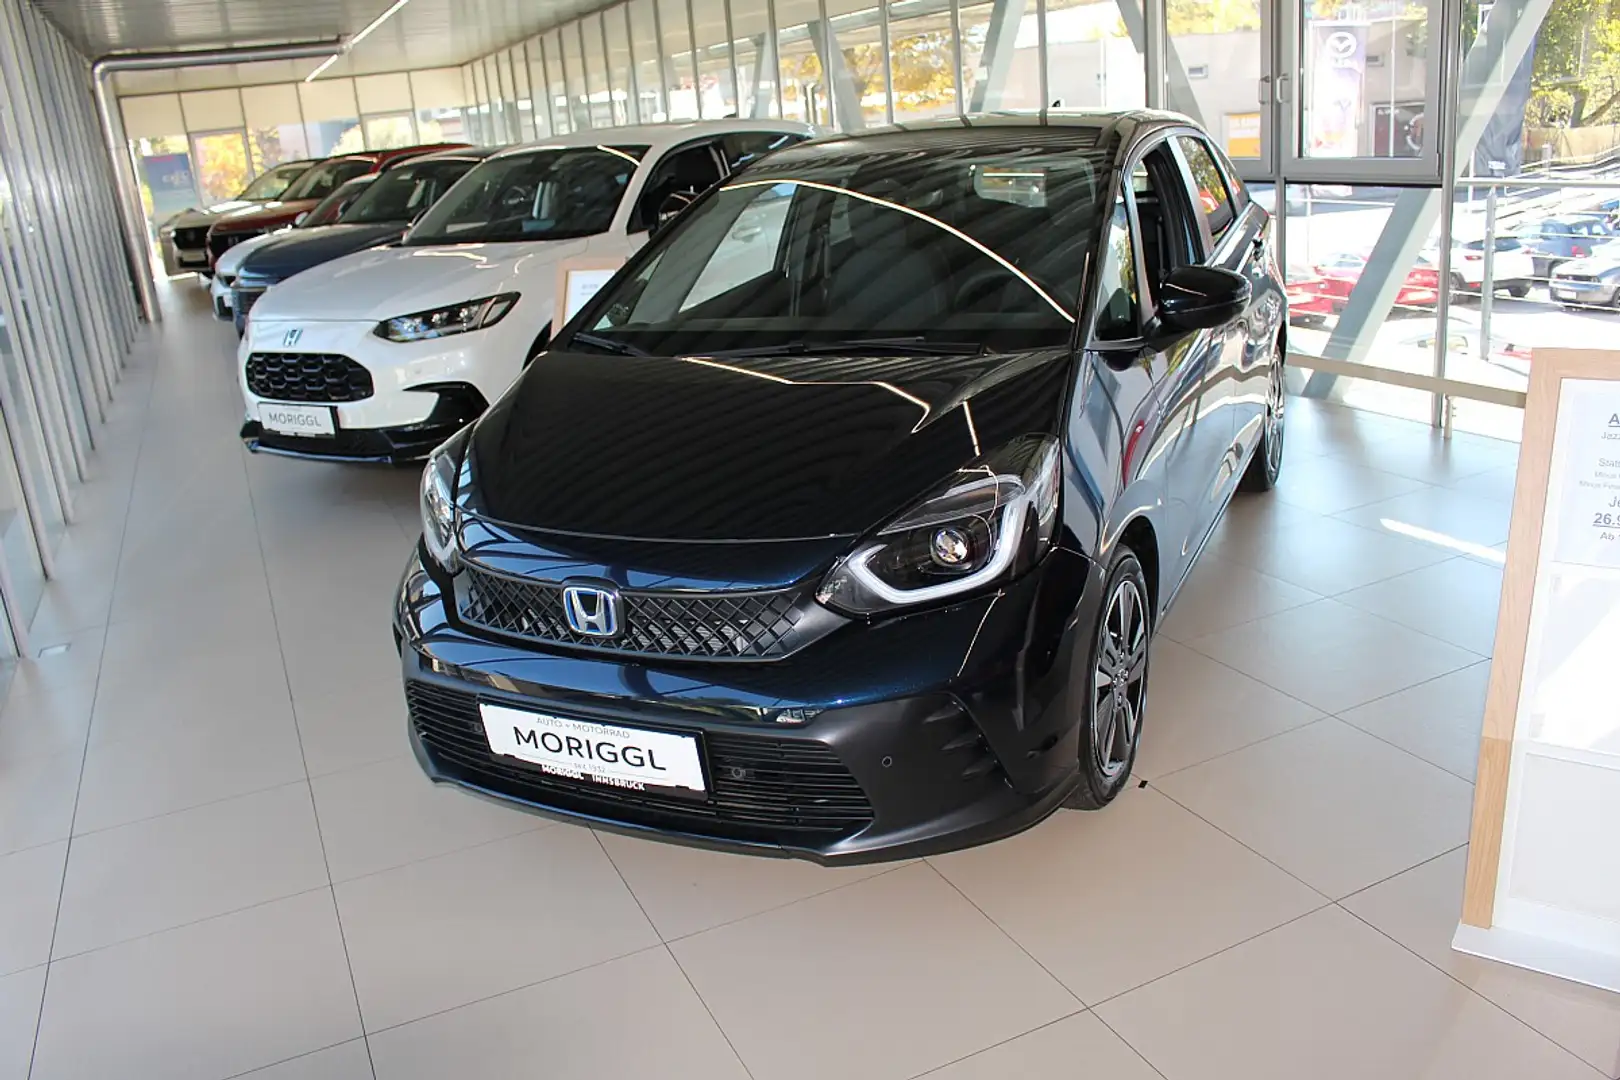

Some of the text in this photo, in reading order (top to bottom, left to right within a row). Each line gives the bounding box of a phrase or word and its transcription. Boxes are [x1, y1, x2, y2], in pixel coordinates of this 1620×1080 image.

[268, 411, 322, 428] MORIGGL
[1608, 413, 1620, 427] A
[536, 717, 563, 728] AUTO
[572, 723, 630, 739] MOTORRAD
[513, 726, 667, 771] MORIGGL
[591, 775, 645, 791] INNSBRUCK
